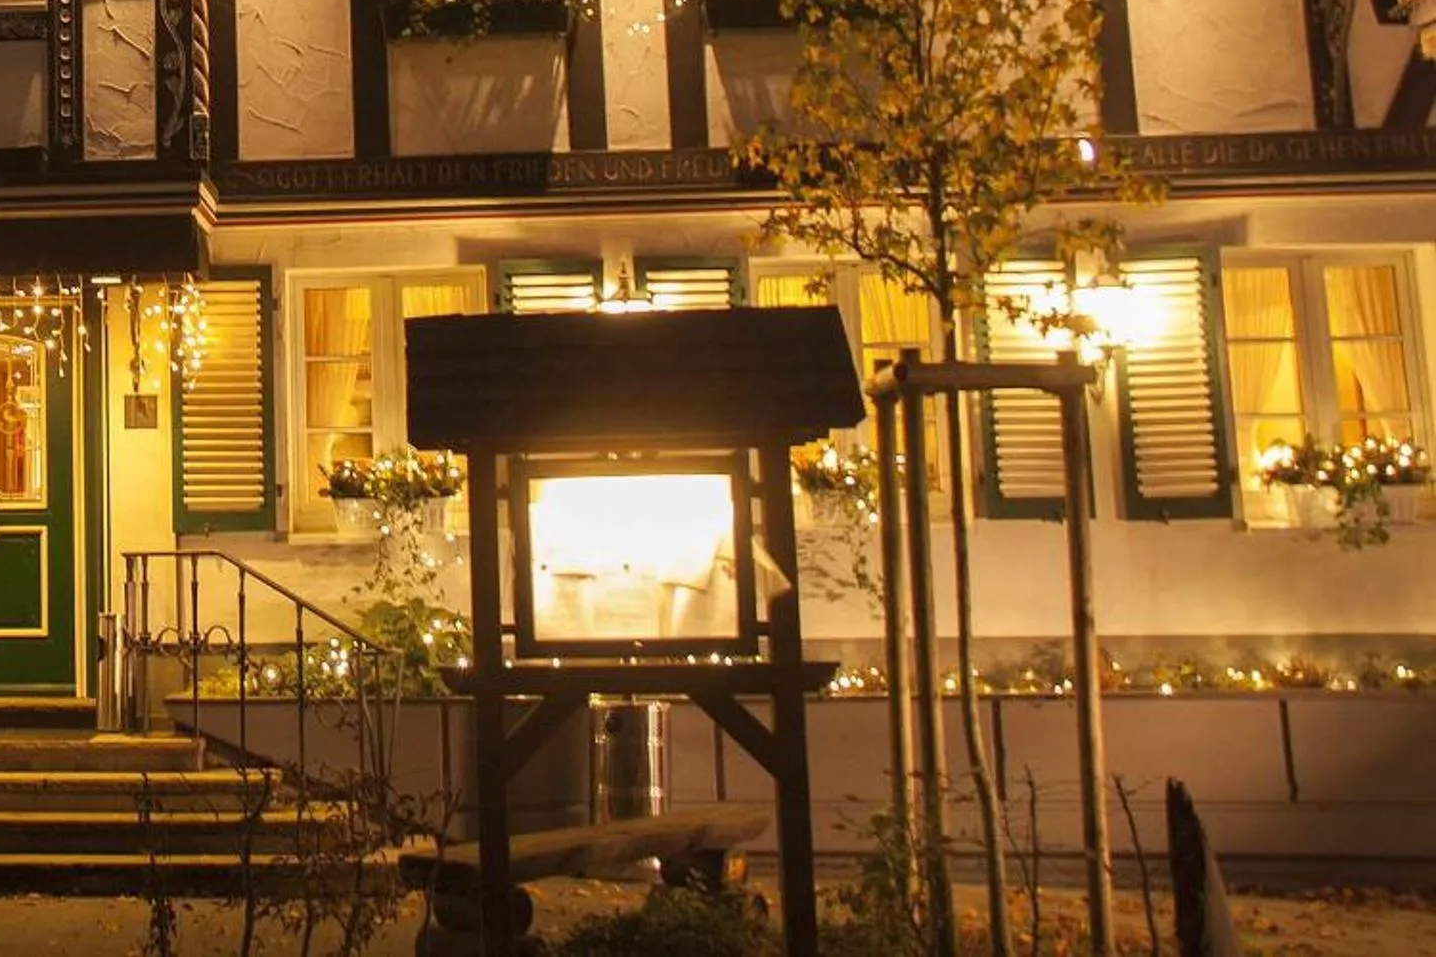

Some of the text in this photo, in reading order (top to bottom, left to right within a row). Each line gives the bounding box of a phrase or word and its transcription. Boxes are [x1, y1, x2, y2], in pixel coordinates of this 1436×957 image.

[1142, 141, 1195, 165] ALLE
[1201, 139, 1240, 164] DIE
[604, 155, 654, 181] UND
